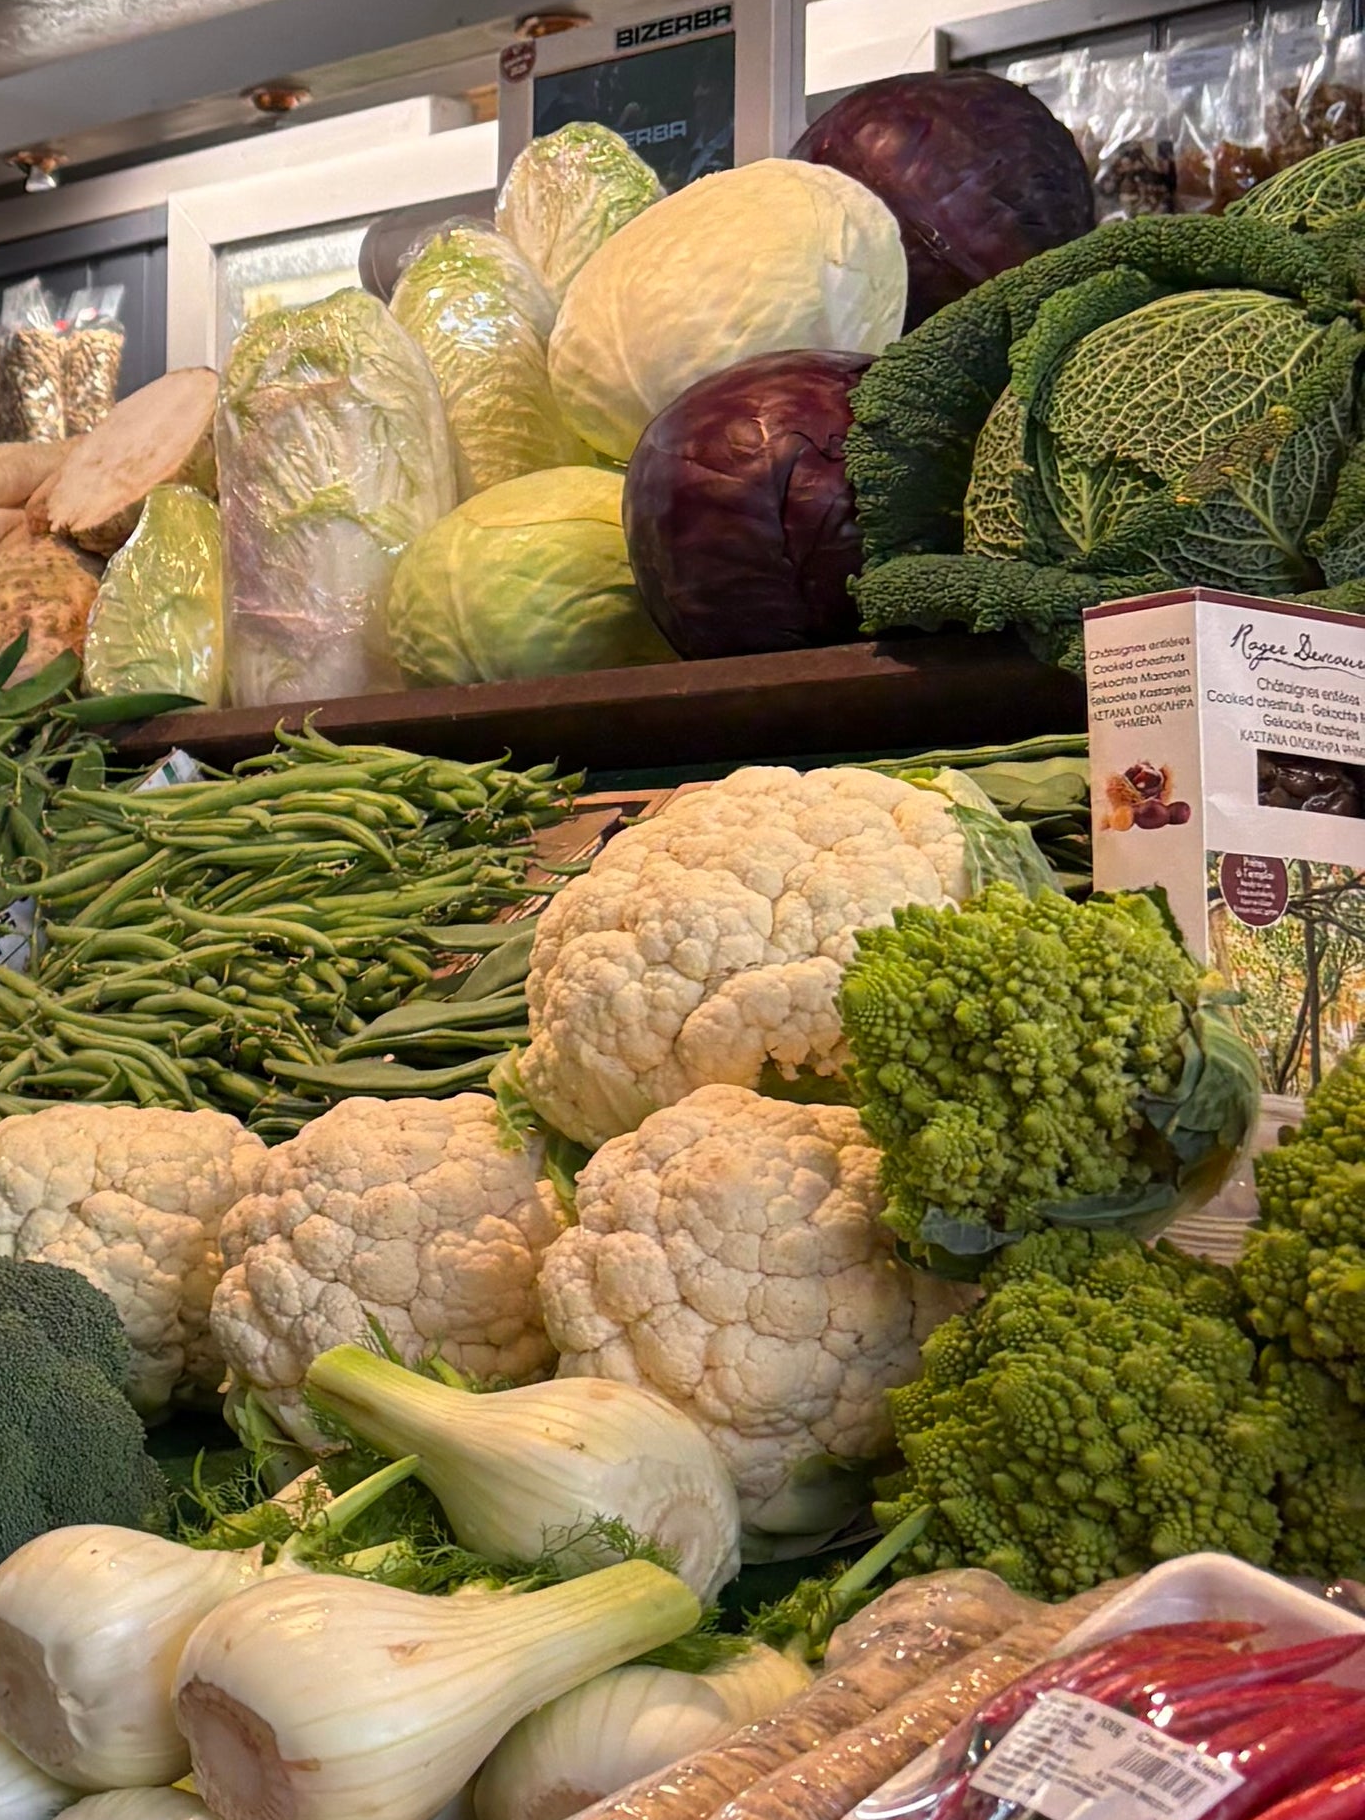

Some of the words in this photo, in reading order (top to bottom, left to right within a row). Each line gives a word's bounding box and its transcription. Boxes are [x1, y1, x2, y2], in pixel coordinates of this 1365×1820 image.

[616, 4, 733, 49] BIZERBA
[621, 120, 687, 148] ERBA
[1093, 660, 1133, 675] Cooked
[1135, 653, 1185, 668] chestnuts
[1206, 689, 1254, 706] Cooked
[1256, 696, 1305, 713] chestnuts
